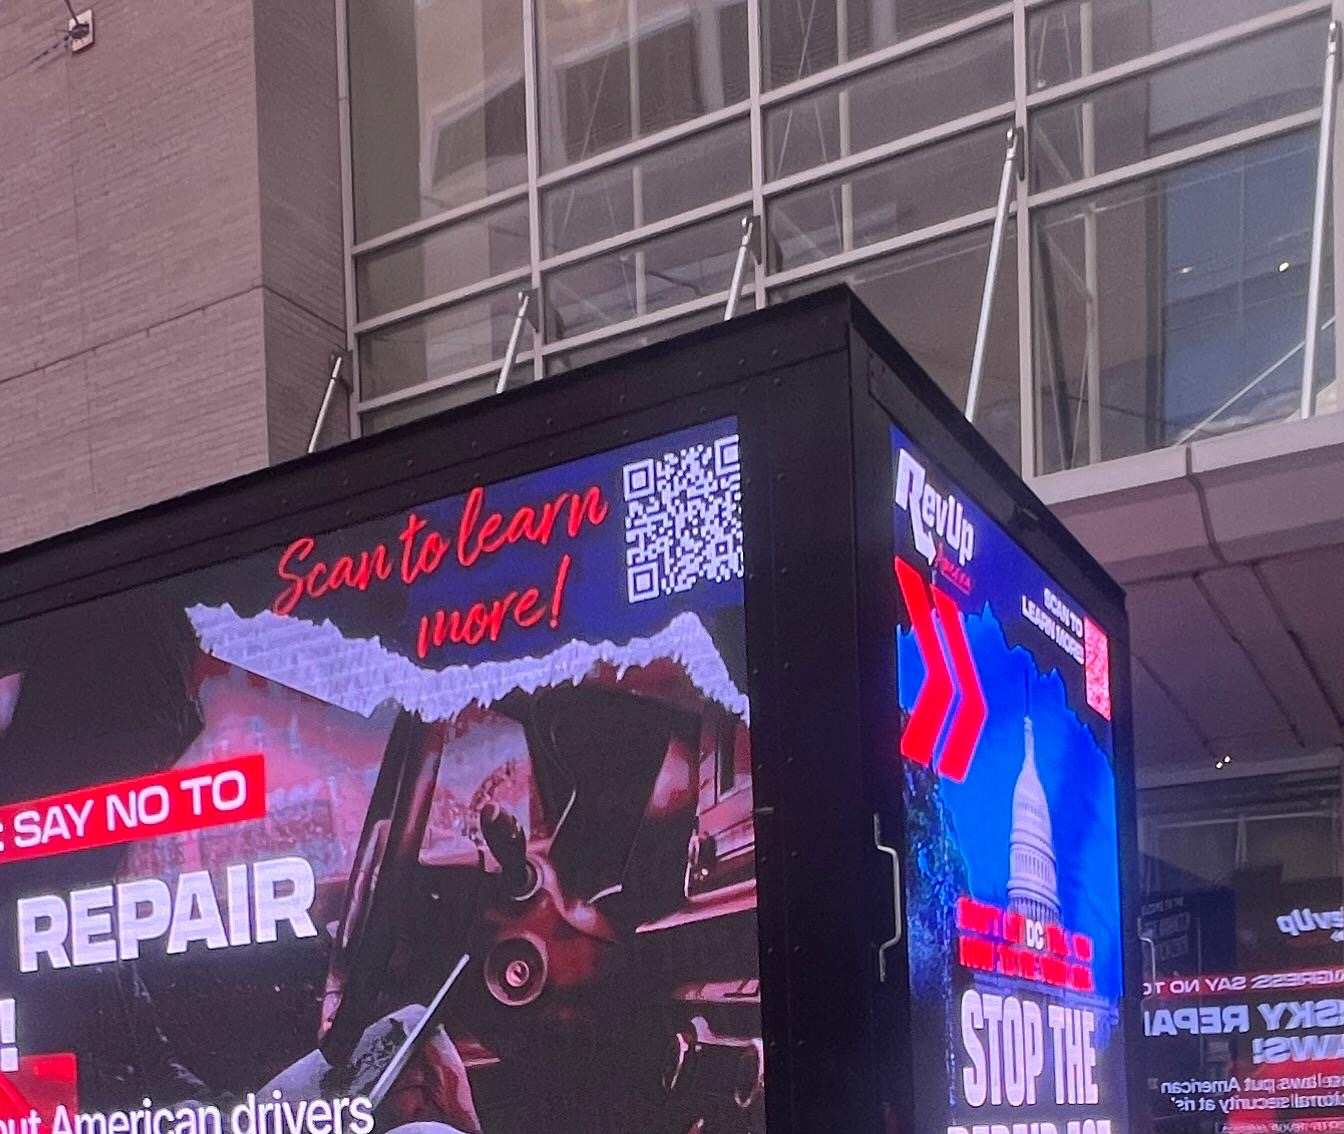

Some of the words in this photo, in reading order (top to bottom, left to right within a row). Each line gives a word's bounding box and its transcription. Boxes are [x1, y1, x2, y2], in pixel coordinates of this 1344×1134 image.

[272, 536, 392, 617] Scan
[399, 513, 449, 584] to
[456, 486, 608, 567] learn
[895, 448, 975, 567] RevUp
[416, 555, 572, 658] more!
[14, 801, 94, 850] SAY
[106, 785, 169, 833] NO
[179, 771, 247, 816] TO
[17, 856, 318, 973] REPAIR
[1026, 918, 1044, 950] DC
[961, 989, 1044, 1107] STOP
[1048, 1004, 1099, 1105] THE
